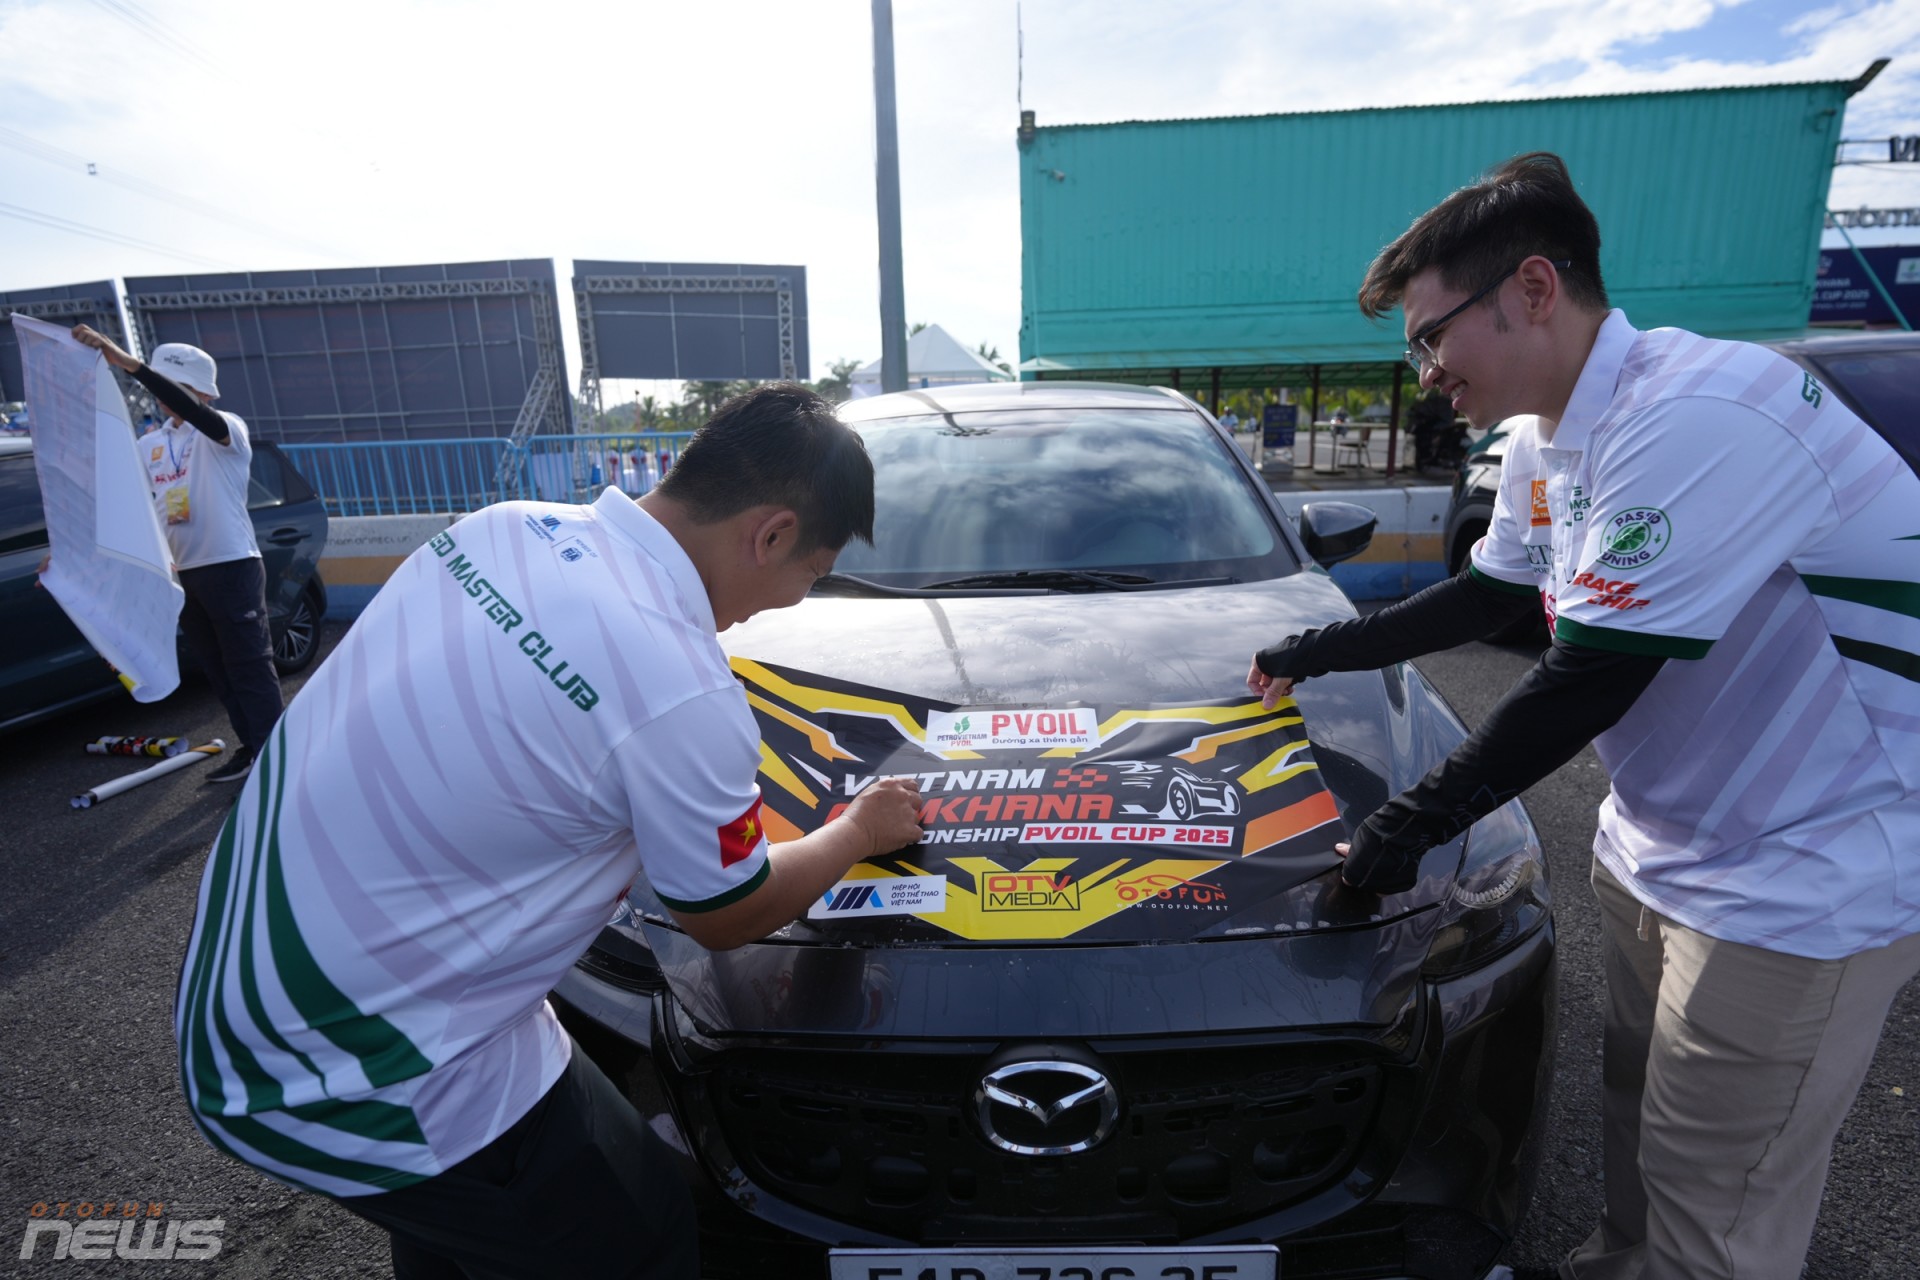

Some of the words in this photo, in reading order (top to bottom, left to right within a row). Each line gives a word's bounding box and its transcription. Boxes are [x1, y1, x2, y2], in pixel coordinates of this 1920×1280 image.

[1602, 551, 1651, 566] UNING
[1573, 573, 1640, 595] RACE
[1586, 594, 1651, 611] CHIP
[446, 553, 523, 634] MASTER
[518, 631, 600, 712] CLUB
[991, 713, 1087, 737] PVOIL
[937, 733, 988, 742] PETROVIETNAM
[845, 768, 1046, 796] VTNAM
[1024, 826, 1103, 841] PVOIL
[1110, 826, 1166, 842] CUP
[1173, 828, 1229, 844] 2025
[988, 875, 1071, 893] OTV
[989, 892, 1074, 906] MEDIA
[1118, 885, 1226, 903] OTOFUN
